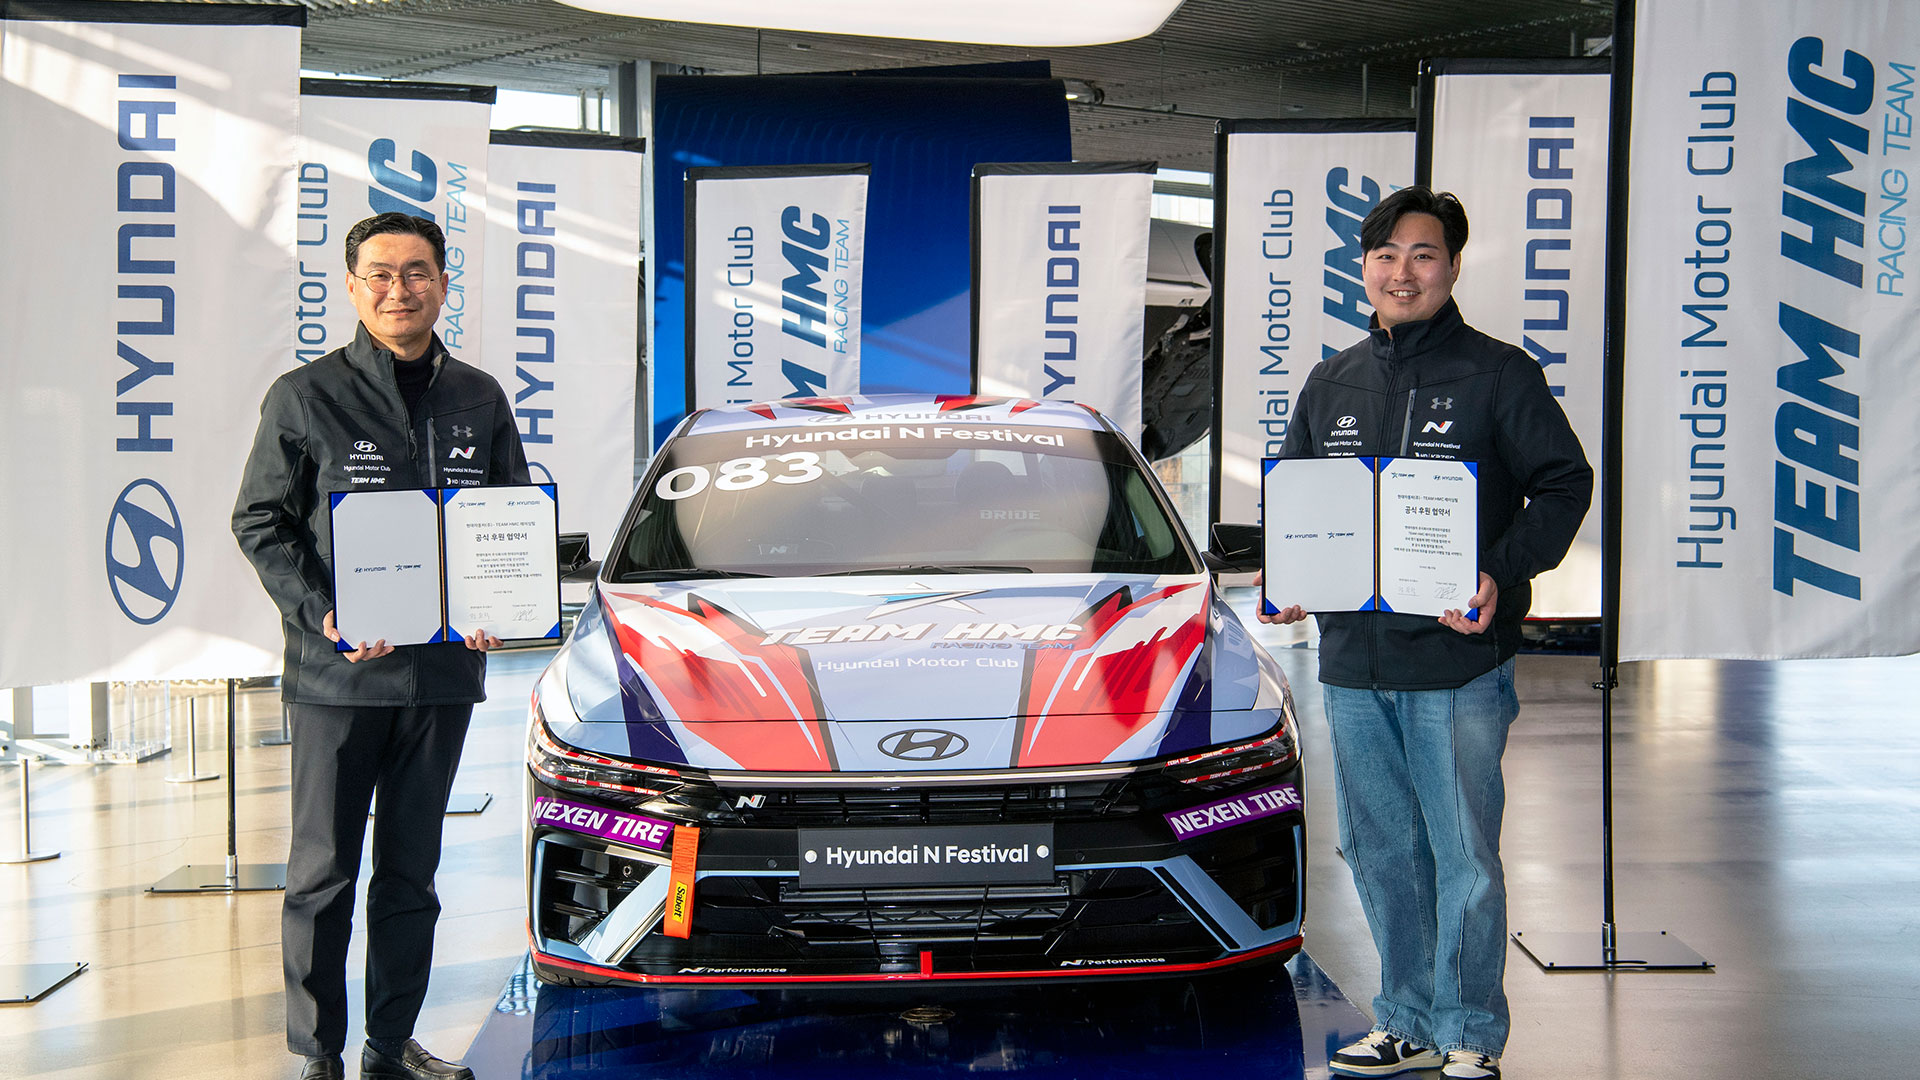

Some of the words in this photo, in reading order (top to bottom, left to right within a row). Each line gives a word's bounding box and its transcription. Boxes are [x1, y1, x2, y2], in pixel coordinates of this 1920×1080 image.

[1687, 71, 1737, 176] Club
[1883, 61, 1916, 156] TEAM
[1780, 36, 1875, 289] HMC
[297, 162, 329, 246] Club
[446, 161, 468, 233] TEAM
[1262, 189, 1294, 259] Club
[727, 226, 754, 286] Club
[834, 219, 850, 272] TEAM
[1876, 168, 1909, 297] RACING
[116, 73, 177, 452] HYUNDAI
[781, 205, 830, 349] HMC
[1681, 195, 1732, 347] Motor
[445, 246, 466, 349] RACING
[515, 181, 556, 444] HYUNDAI
[834, 279, 849, 354] RACING
[1043, 205, 1081, 404] YUNDAI
[1259, 272, 1291, 375] Motor
[727, 297, 754, 386] Motor
[745, 427, 891, 448] Hyundai
[899, 427, 924, 439] N
[934, 427, 1065, 447] Festival
[865, 413, 991, 421] HYUNDAI
[1330, 429, 1359, 437] HYUNDAI
[343, 464, 364, 472] Hyundai
[443, 466, 463, 474] Hyundai
[1413, 441, 1434, 449] Hyundai
[1440, 442, 1461, 450] Festival
[1676, 370, 1737, 568] Hyundai
[1773, 301, 1862, 601] TEAM
[655, 451, 823, 501] 083
[475, 533, 489, 542] 공식
[491, 533, 505, 542] 후원
[980, 510, 1041, 520] BRIDE
[759, 622, 938, 646] TEAM
[944, 622, 1088, 642] HMC
[930, 641, 1013, 650] RACING
[1019, 641, 1076, 651] TEAM
[817, 658, 900, 674] Hyundai
[906, 657, 969, 669] Motor
[975, 656, 1020, 669] Club
[532, 801, 608, 831] NEXEN
[610, 815, 669, 844] TIRE
[1170, 799, 1252, 835] NEXEN
[1248, 787, 1303, 812] TIRE
[826, 845, 918, 869] Hyundai
[923, 845, 940, 863] N
[945, 843, 1029, 863] Festival
[673, 886, 687, 918] Sabelt
[707, 966, 787, 974] Performance
[1087, 956, 1166, 966] Performance
